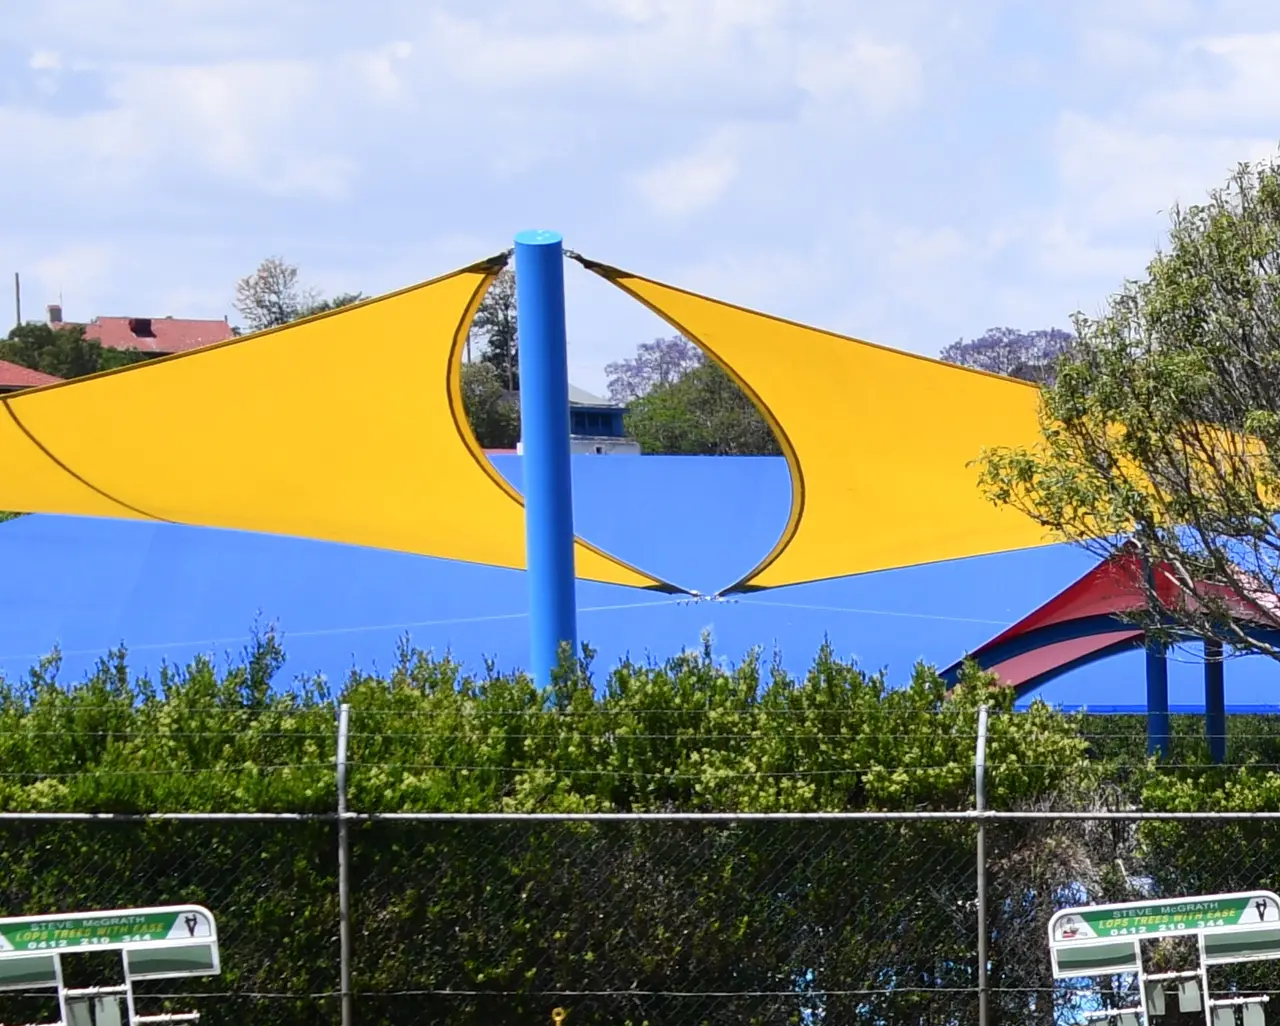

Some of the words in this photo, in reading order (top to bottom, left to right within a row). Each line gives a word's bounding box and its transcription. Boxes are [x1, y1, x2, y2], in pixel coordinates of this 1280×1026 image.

[1112, 907, 1152, 918] STEVE
[1161, 902, 1219, 914] McGRATH
[30, 920, 73, 931] STEVE
[82, 916, 146, 927] McGRATH
[1098, 918, 1129, 929] LOPS
[1134, 915, 1170, 926] TREES
[1173, 912, 1202, 922] WITH
[1206, 908, 1236, 919] EASE
[15, 930, 48, 942] LOPS
[54, 927, 91, 939] TREES
[97, 925, 128, 936] WITH
[1110, 926, 1147, 936] 0412
[1158, 922, 1186, 932] 210
[1197, 919, 1225, 928] 344
[27, 939, 67, 949] 0412
[80, 936, 110, 945] 210
[122, 933, 152, 943] 344
